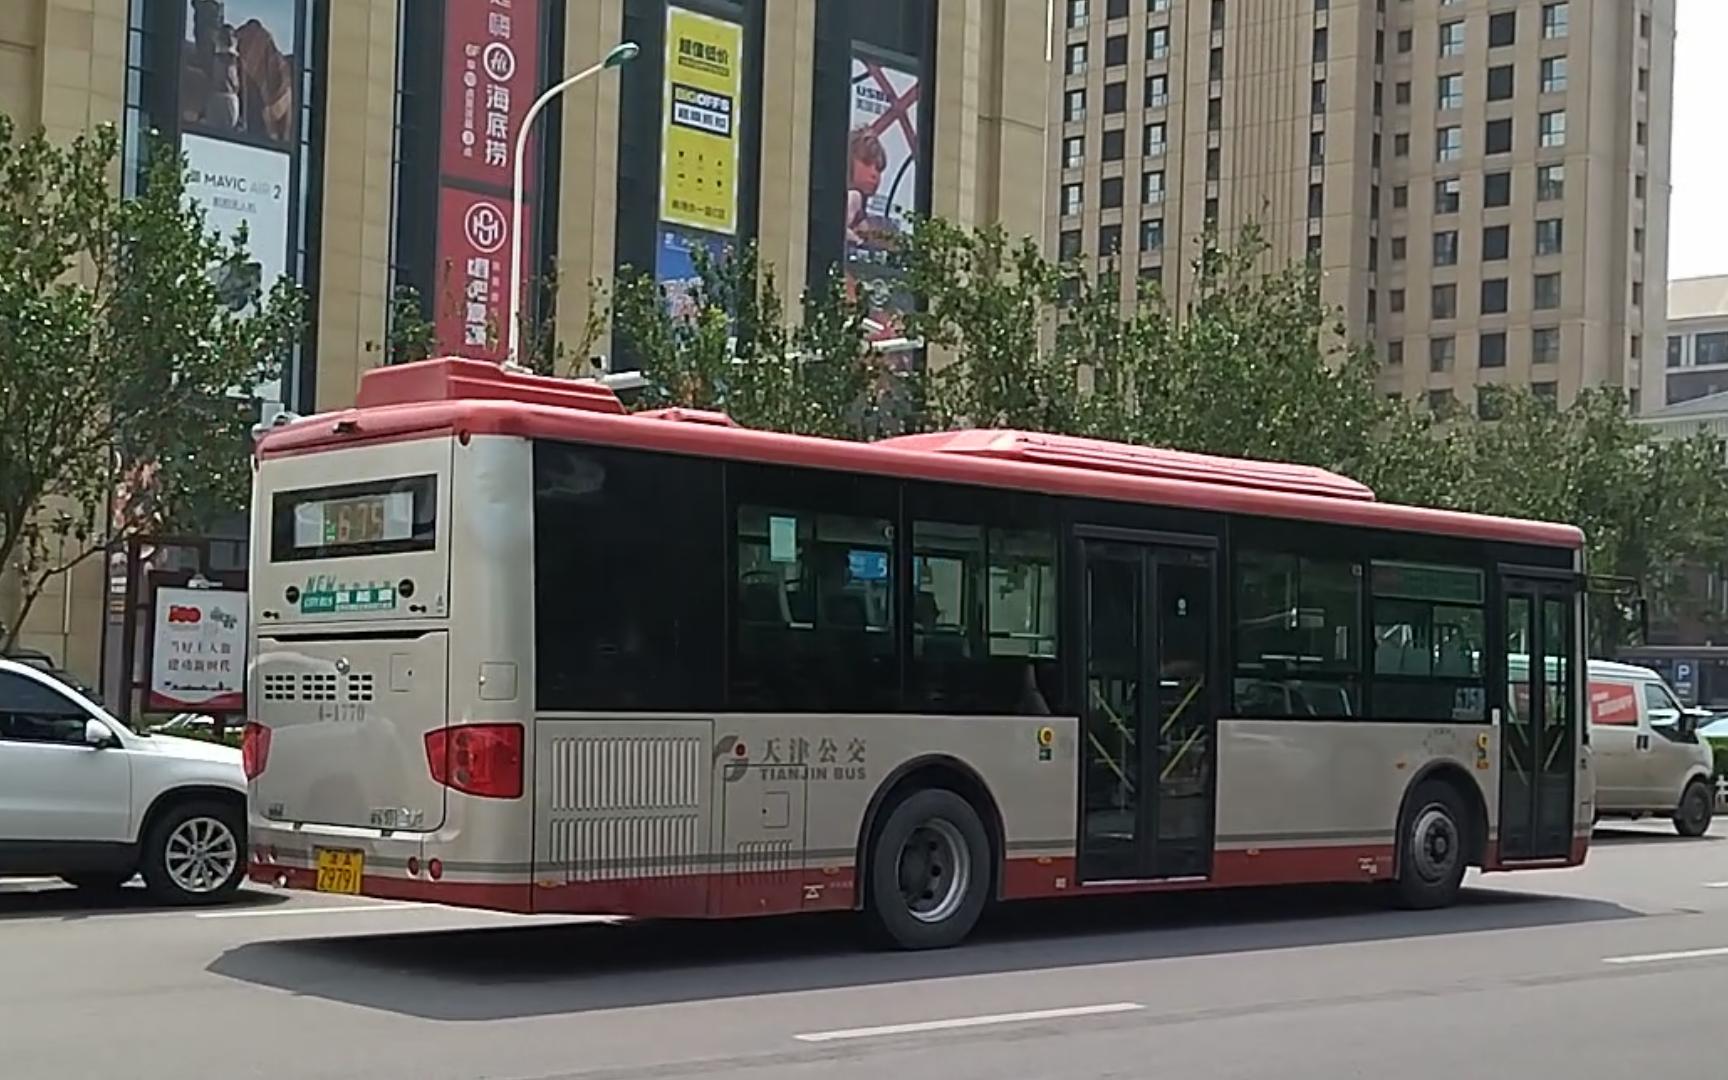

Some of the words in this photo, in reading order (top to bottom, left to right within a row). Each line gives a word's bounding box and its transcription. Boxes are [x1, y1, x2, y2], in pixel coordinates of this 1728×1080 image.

[485, 83, 510, 168] 海底捞
[204, 173, 247, 193] MAVIC
[273, 183, 283, 200] 2
[1678, 664, 1690, 680] P
[761, 737, 866, 763] 天津公交
[760, 767, 827, 780] TIANJIN
[834, 767, 866, 780] BUS
[320, 867, 357, 890] 79791
